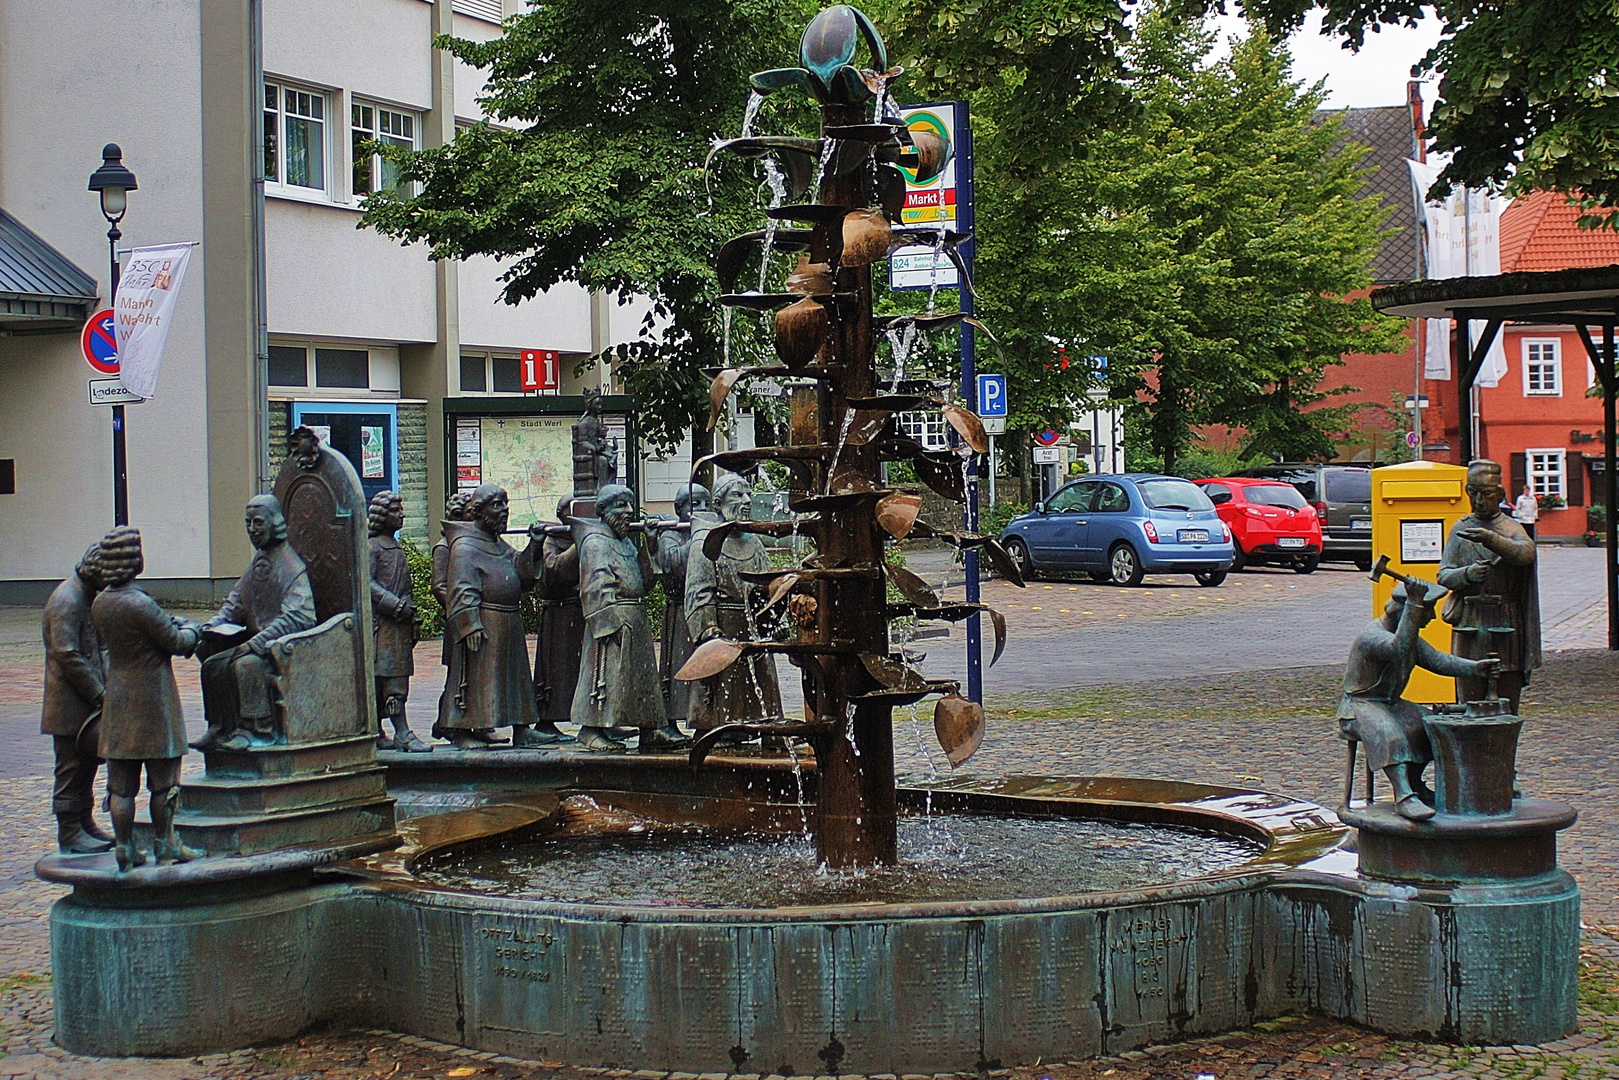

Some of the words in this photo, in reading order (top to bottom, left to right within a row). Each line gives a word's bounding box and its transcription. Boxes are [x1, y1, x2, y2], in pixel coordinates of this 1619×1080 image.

[908, 193, 937, 205] Markt
[893, 258, 909, 269] 624
[119, 273, 152, 289] Jahr
[985, 380, 1000, 411] P
[494, 946, 547, 962] GERICHT
